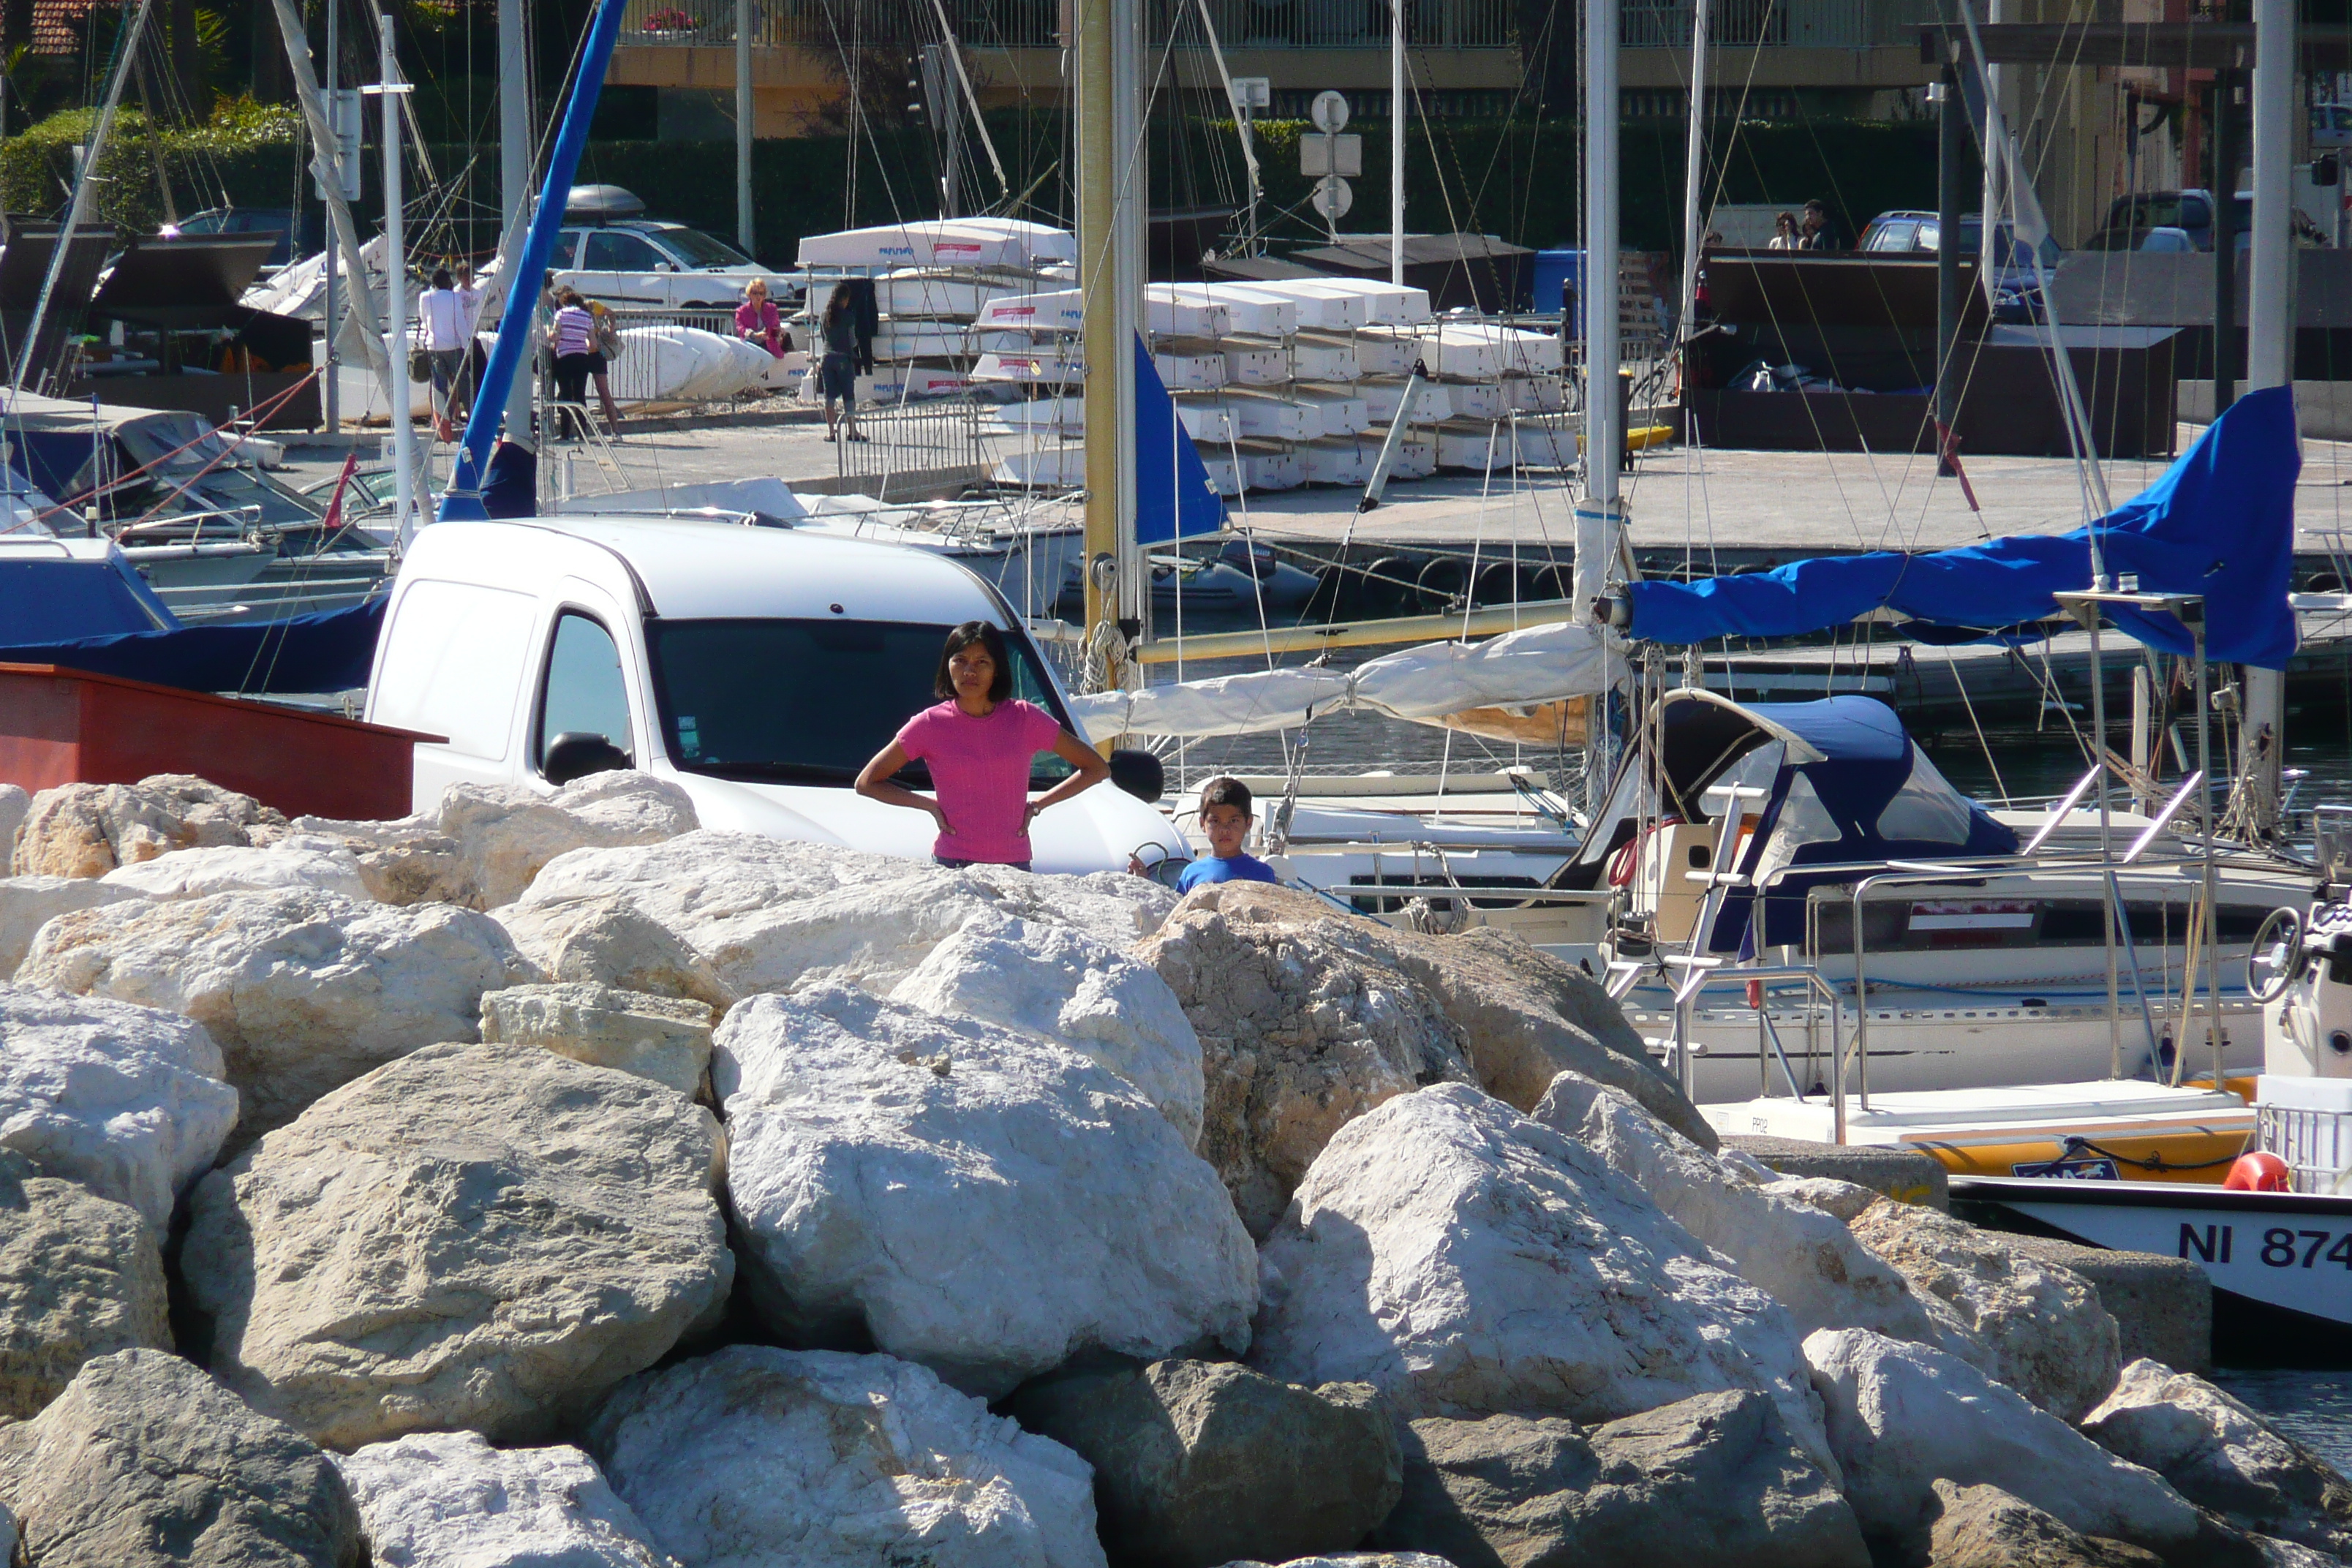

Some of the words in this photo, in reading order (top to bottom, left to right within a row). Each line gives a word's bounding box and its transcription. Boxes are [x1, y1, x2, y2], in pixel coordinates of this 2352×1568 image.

[1752, 1117, 1768, 1134] PP02
[2179, 1223, 2233, 1263] NI
[2261, 1228, 2352, 1271] 874
